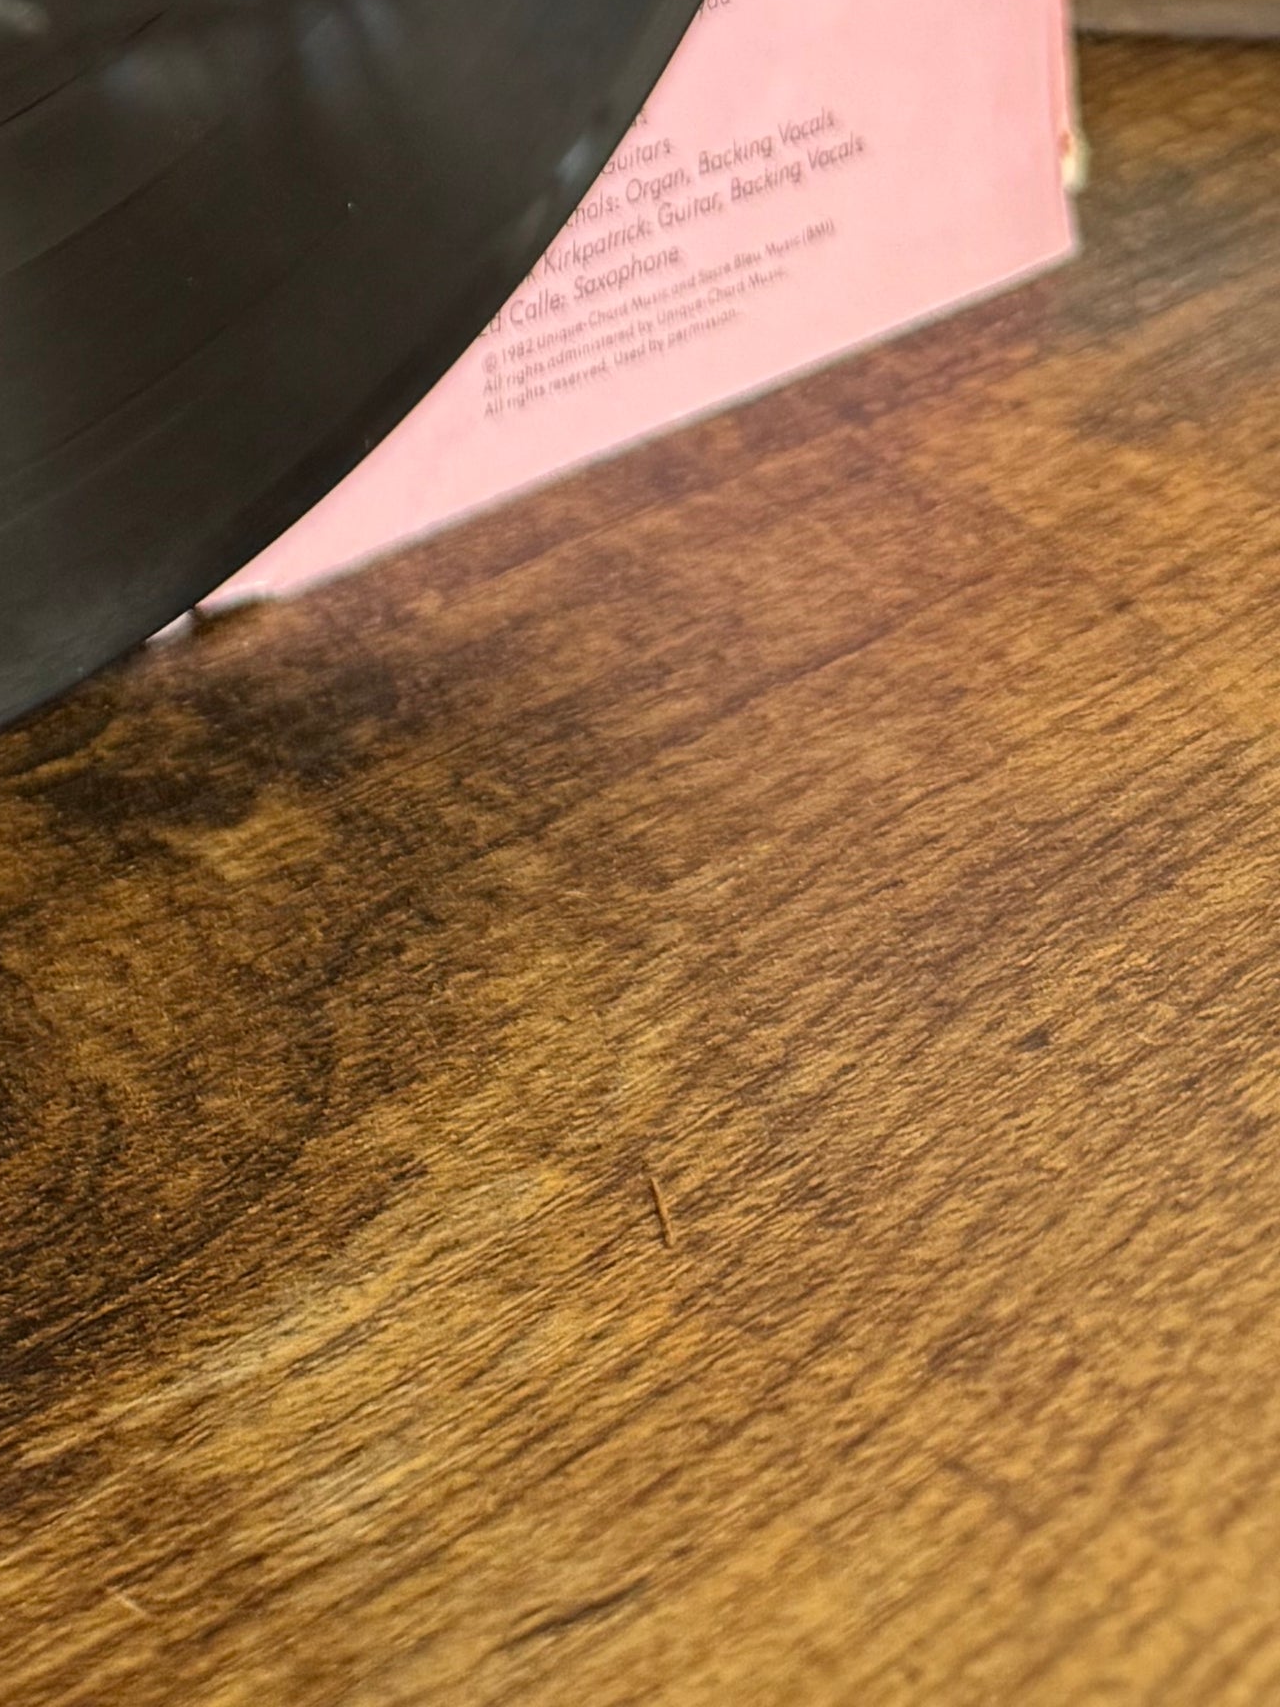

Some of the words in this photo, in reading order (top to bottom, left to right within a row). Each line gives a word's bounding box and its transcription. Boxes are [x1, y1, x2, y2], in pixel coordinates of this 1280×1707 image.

[656, 194, 724, 227] Guitar,
[730, 160, 803, 202] Backing
[805, 134, 865, 172] Vocals
[509, 292, 565, 327] Calle:
[573, 245, 681, 302] Saxophone
